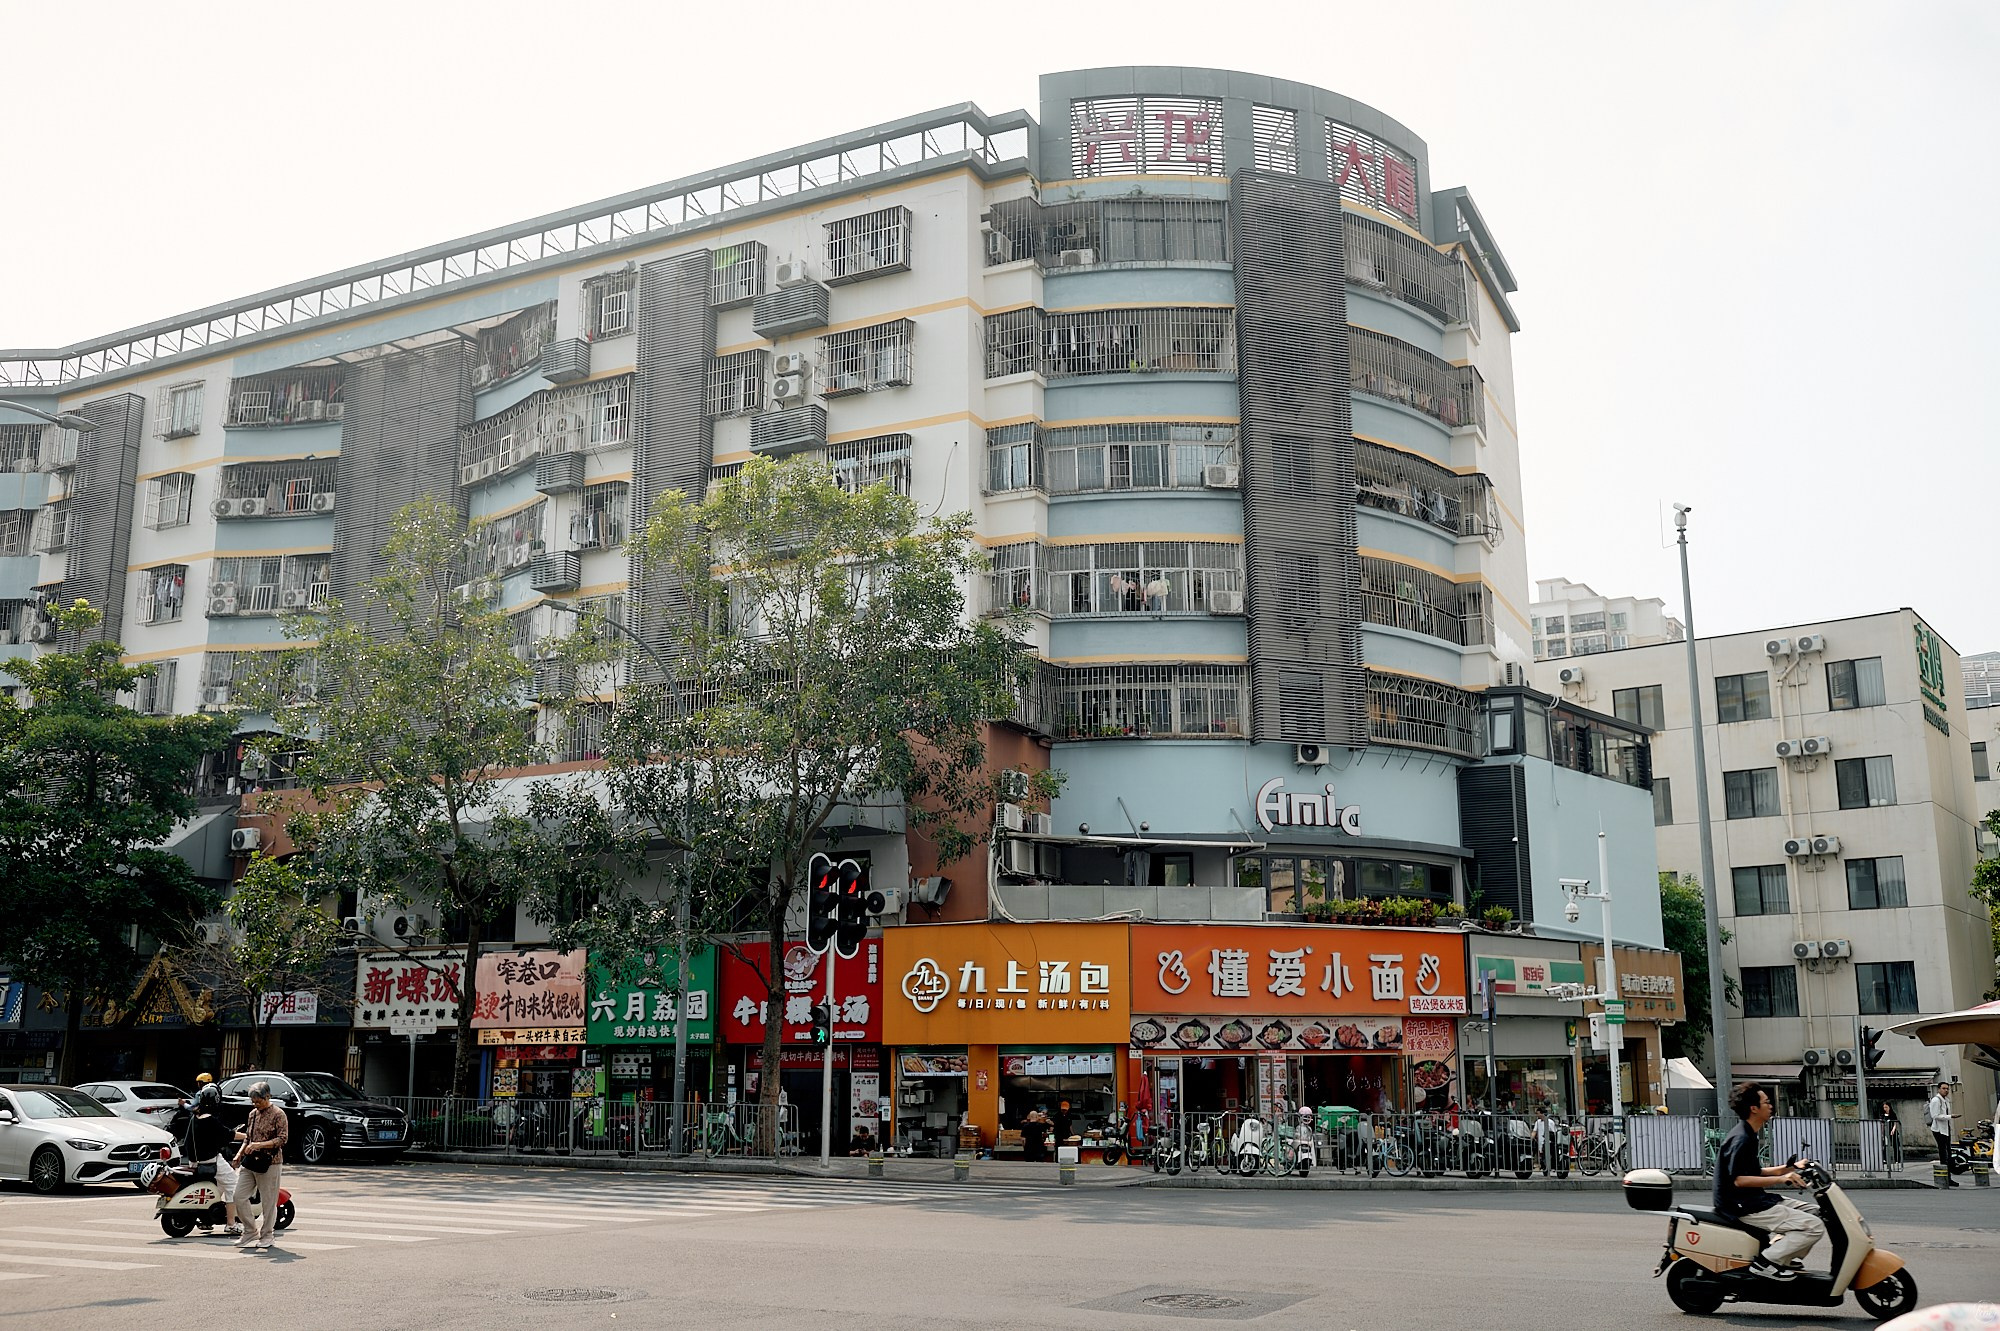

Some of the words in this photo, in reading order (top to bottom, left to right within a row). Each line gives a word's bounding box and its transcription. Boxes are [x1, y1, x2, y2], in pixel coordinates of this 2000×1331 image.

[497, 957, 560, 985] 窄巷口
[957, 960, 1110, 994] 九上汤包
[1210, 947, 1405, 1001] 懂爱小面
[363, 962, 460, 1005] 新螺说
[263, 994, 297, 1014] 招租
[591, 990, 708, 1022] 六月荔园
[1412, 998, 1464, 1011] 鸡公煲&米饭
[1406, 1021, 1451, 1037] 新品上市
[780, 1050, 846, 1062] 现切牛肉正潮味
[1406, 1037, 1450, 1051] 懂爱鸡公煲
